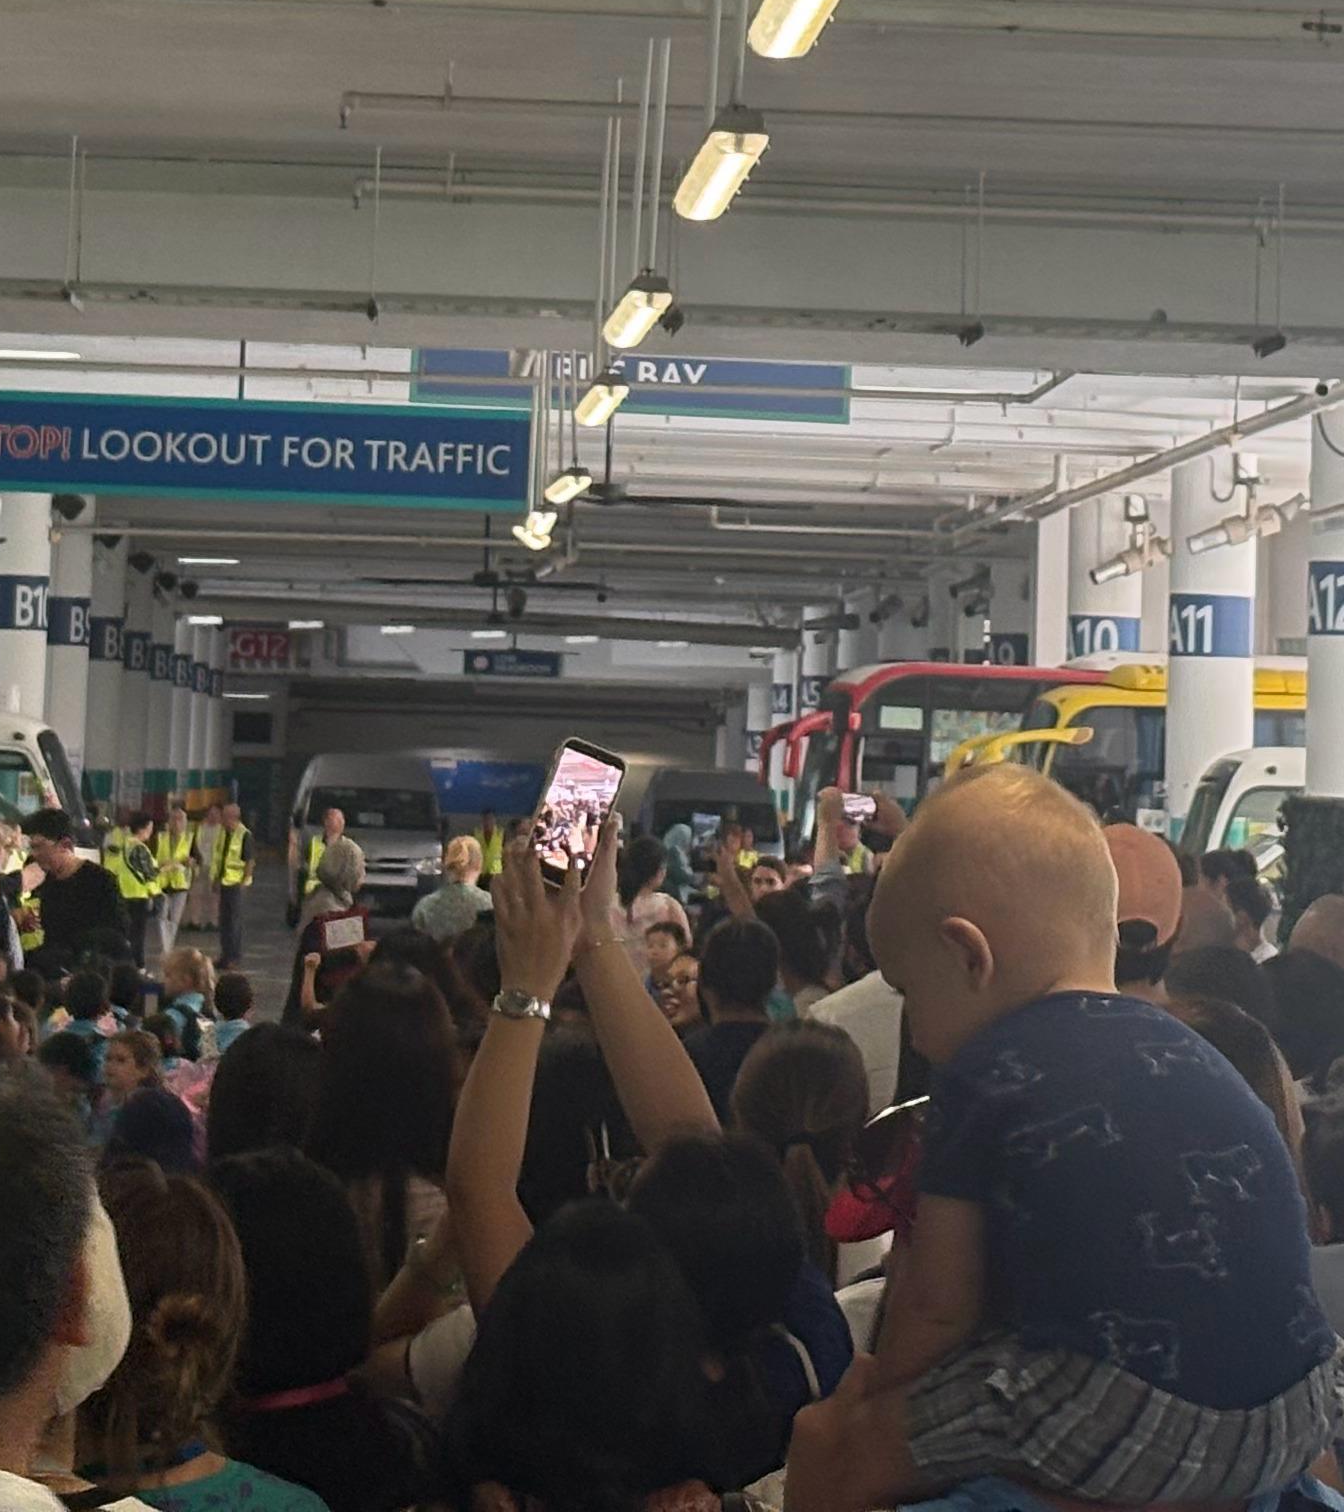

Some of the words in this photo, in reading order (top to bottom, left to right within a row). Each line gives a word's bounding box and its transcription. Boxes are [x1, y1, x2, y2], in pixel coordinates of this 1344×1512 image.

[82, 428, 271, 467] LOOKOUT
[281, 435, 356, 471] FOR
[364, 438, 512, 476] TRAFFIC
